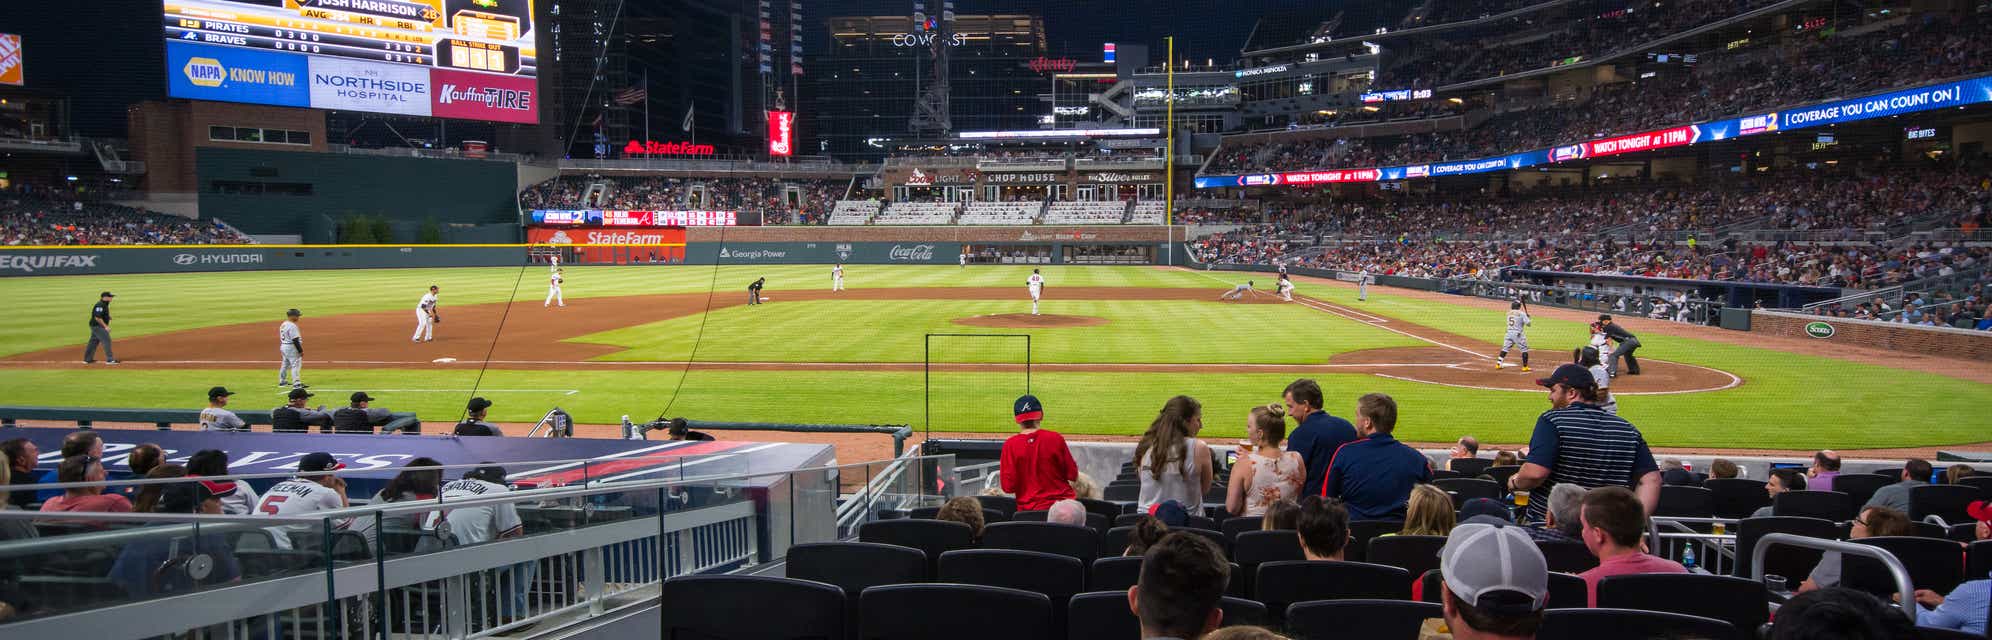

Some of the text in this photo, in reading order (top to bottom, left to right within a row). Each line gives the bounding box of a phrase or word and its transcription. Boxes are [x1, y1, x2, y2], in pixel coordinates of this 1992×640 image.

[306, 10, 326, 19] AVG
[351, 0, 416, 17] HARRISON
[423, 8, 437, 20] 2B
[360, 16, 372, 25] HR
[398, 21, 412, 30] RBI
[205, 20, 249, 34] PIRATES
[275, 30, 282, 38] 0
[288, 30, 294, 39] 3
[300, 32, 307, 40] 0
[312, 33, 320, 42] 0
[205, 33, 247, 46] BRAVES
[313, 45, 320, 53] 0
[190, 64, 295, 86] NAPA KNOW HOW
[1263, 65, 1287, 74] MINOLTA
[316, 74, 425, 94] NORTHSIDE
[337, 90, 406, 102] HOSPITAL
[440, 84, 531, 110] Kauffman TIRE
[1414, 90, 1432, 99] 9:03
[1791, 108, 1839, 124] COVERAGE
[1841, 104, 1863, 116] YOU
[1866, 101, 1888, 114] CAN
[1891, 94, 1929, 109] COUNT
[1932, 90, 1951, 102] ON
[1919, 129, 1936, 138] BITES
[1594, 130, 1686, 154] WATCH TONIGHT AT 11PM
[1437, 164, 1464, 173] COVERAGE
[1464, 162, 1476, 171] YOU
[988, 174, 1055, 182] CHOP HOUSE
[1286, 174, 1310, 182] WATCH
[1311, 172, 1342, 181] TONIGHT
[1354, 170, 1374, 180] 11PM
[587, 232, 663, 244] StateFarm
[200, 254, 262, 264] HYUNDAI
[732, 250, 761, 259] Georgia
[0, 255, 96, 271] EQUIFAX
[1509, 317, 1515, 326] 5
[444, 480, 488, 495] SWANSON
